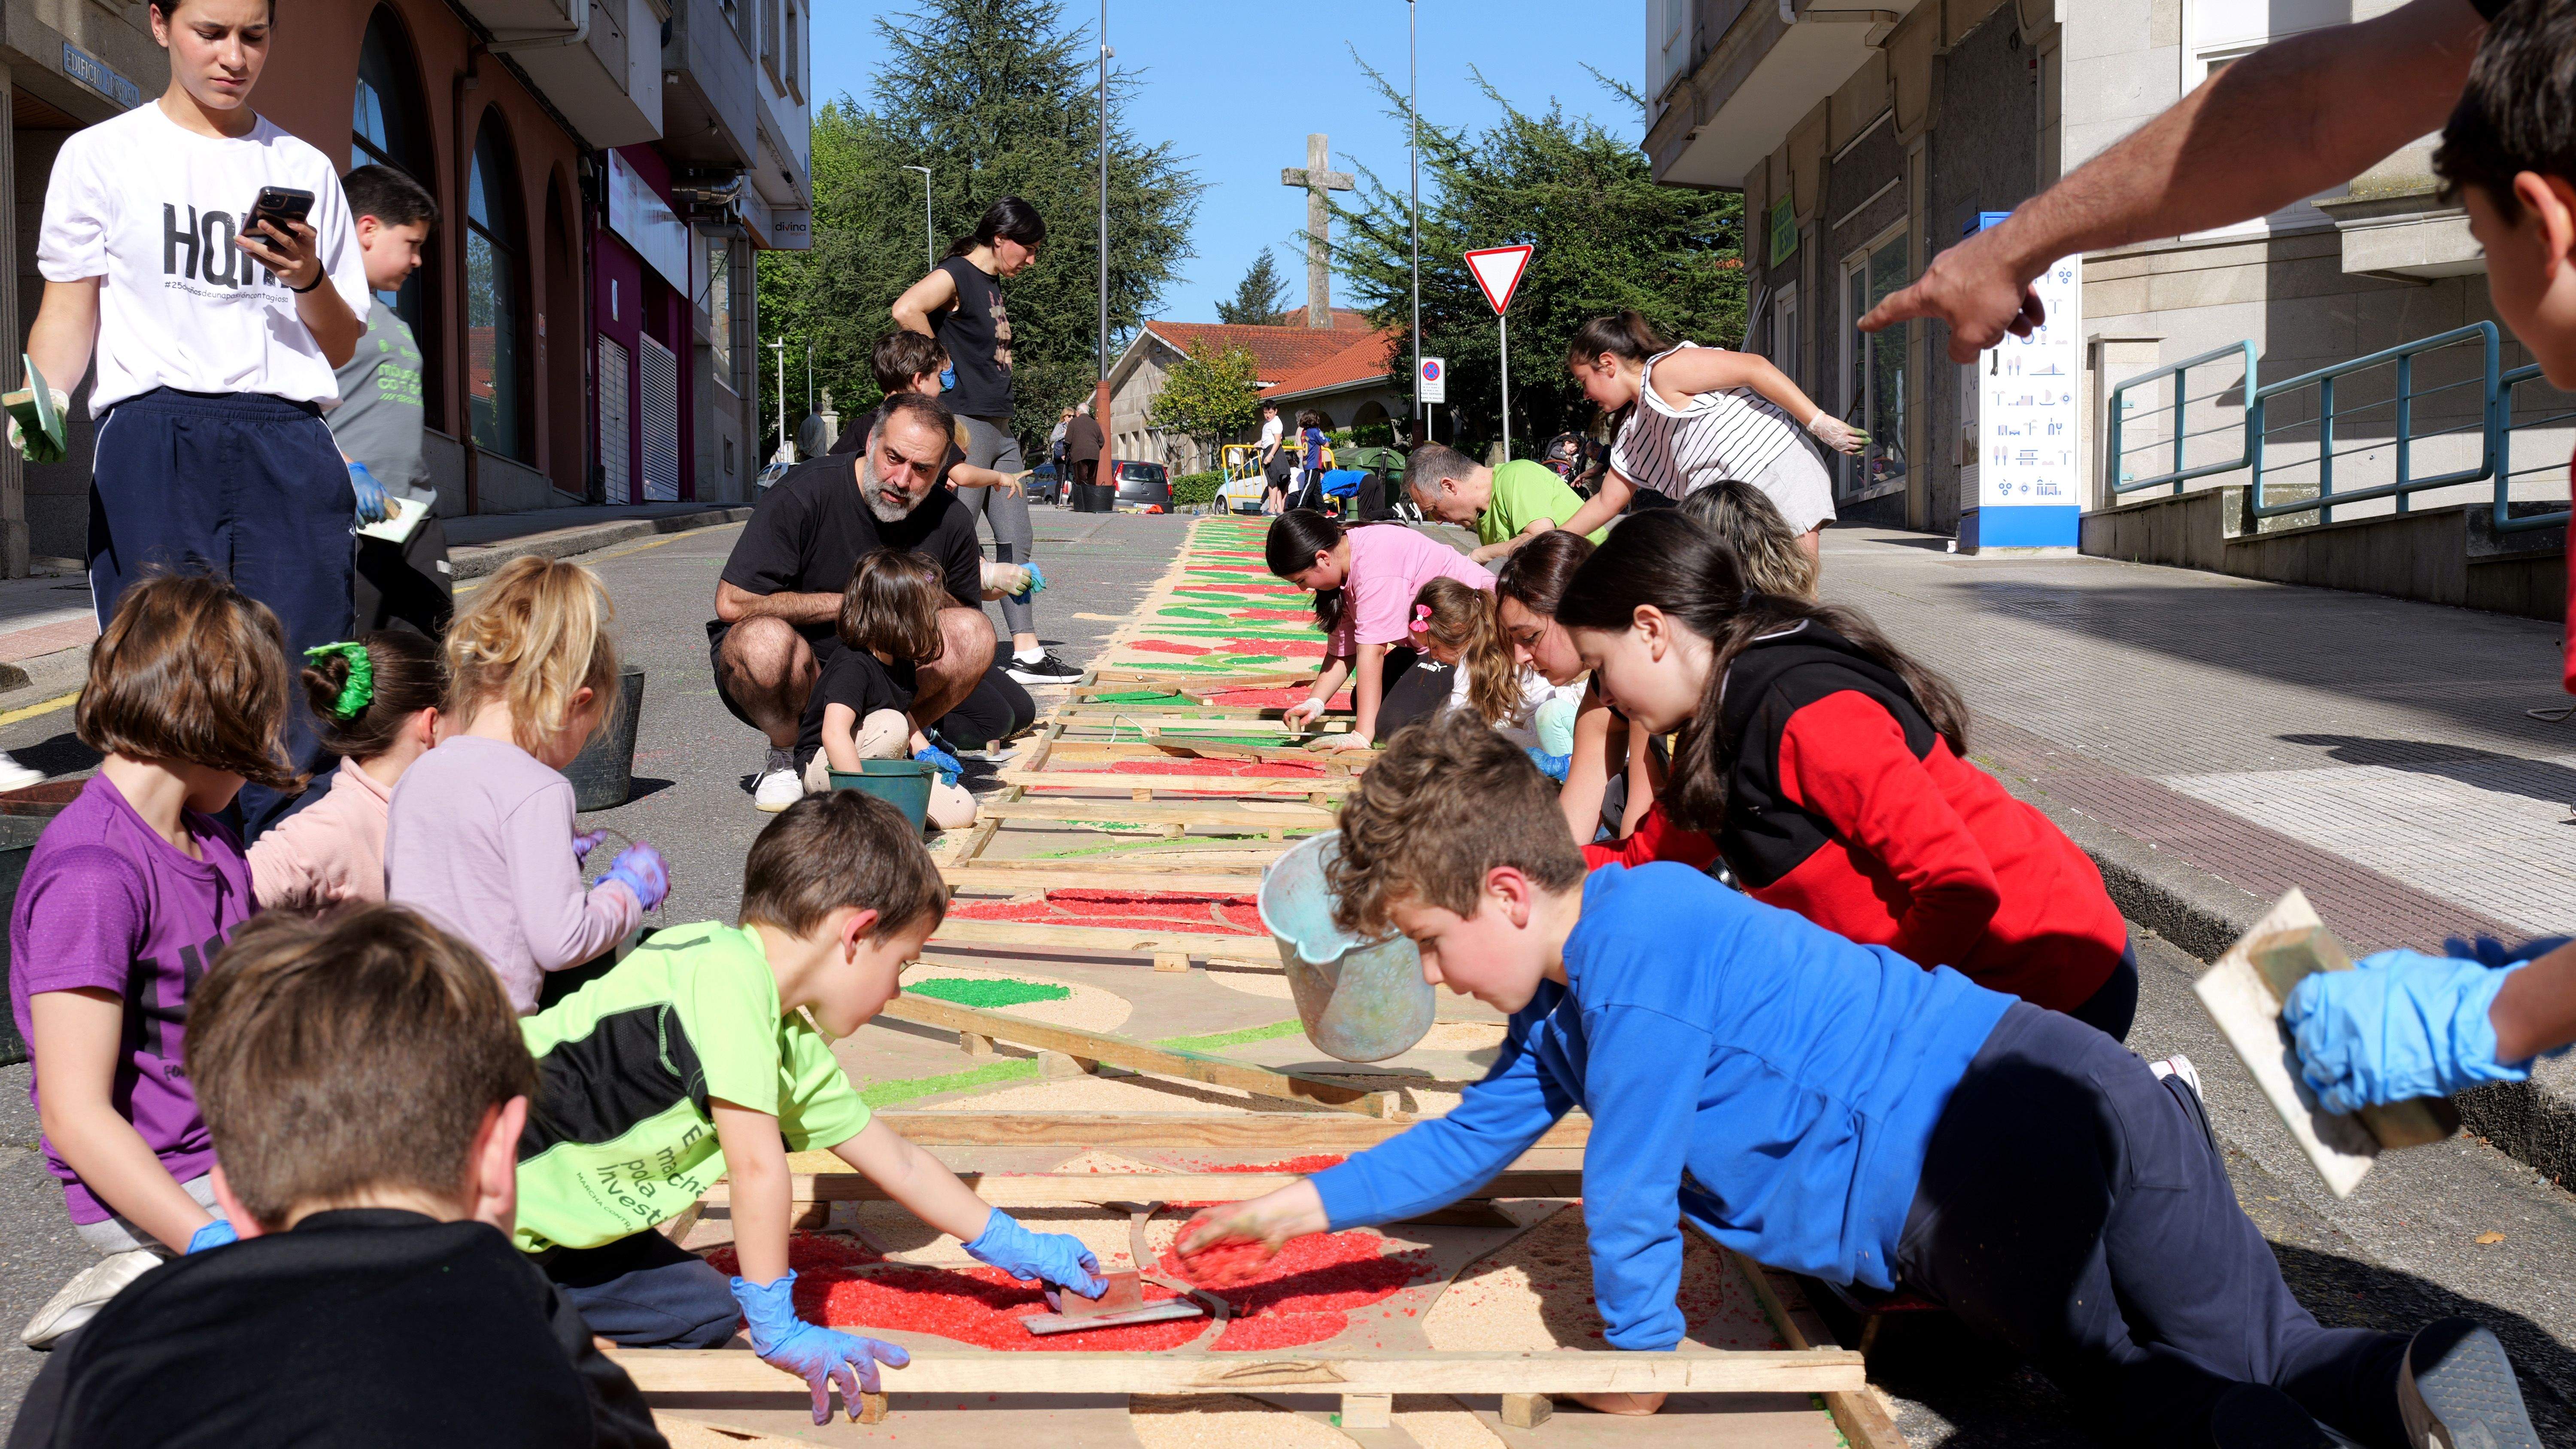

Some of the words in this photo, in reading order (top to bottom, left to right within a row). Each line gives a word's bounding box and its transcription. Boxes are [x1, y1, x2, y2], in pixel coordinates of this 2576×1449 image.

[67, 49, 103, 86] EDIFICIO
[106, 74, 138, 107] ARNOSA
[775, 222, 806, 231] divina
[577, 1173, 602, 1207] MARCHA
[620, 1159, 656, 1198] pola
